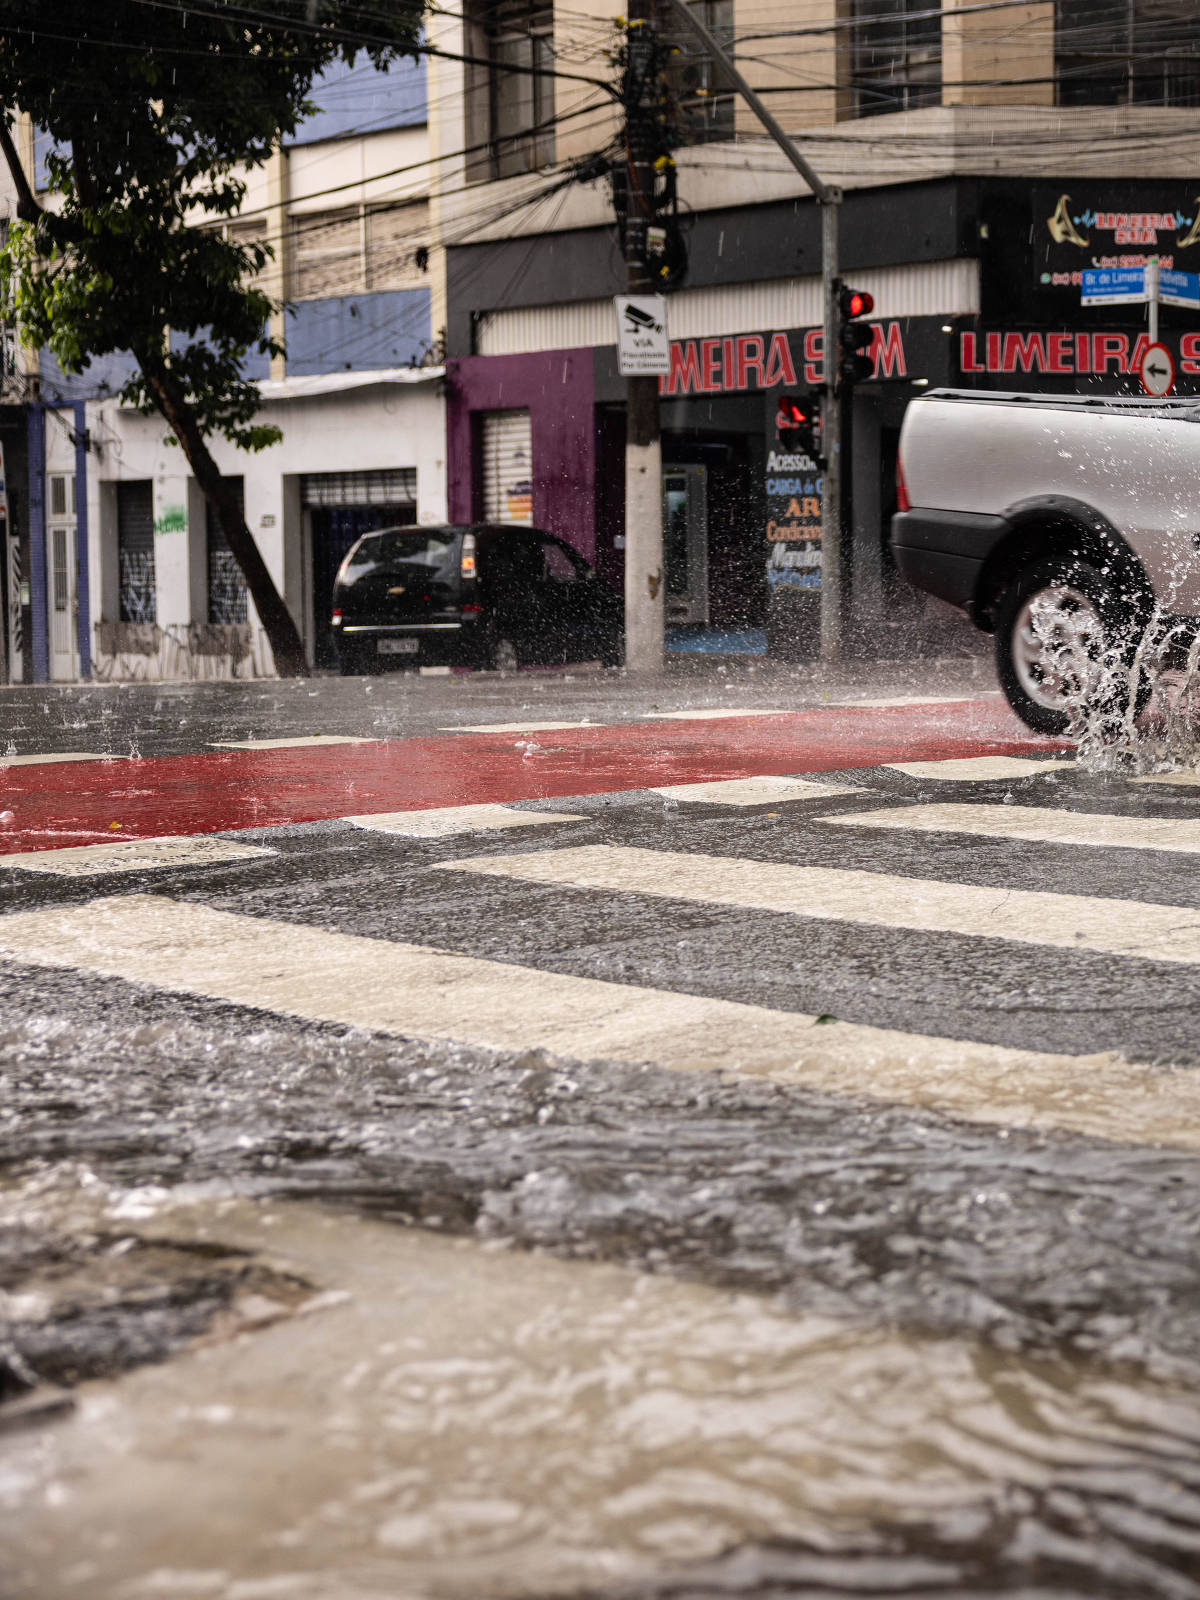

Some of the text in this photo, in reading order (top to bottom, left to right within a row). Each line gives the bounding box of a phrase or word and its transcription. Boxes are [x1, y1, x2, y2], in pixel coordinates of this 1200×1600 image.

[1096, 212, 1177, 230] LIMEIRA
[658, 321, 908, 396] MEIRA SM
[960, 331, 1152, 374] LIMEIRA
[784, 497, 821, 518] AR
